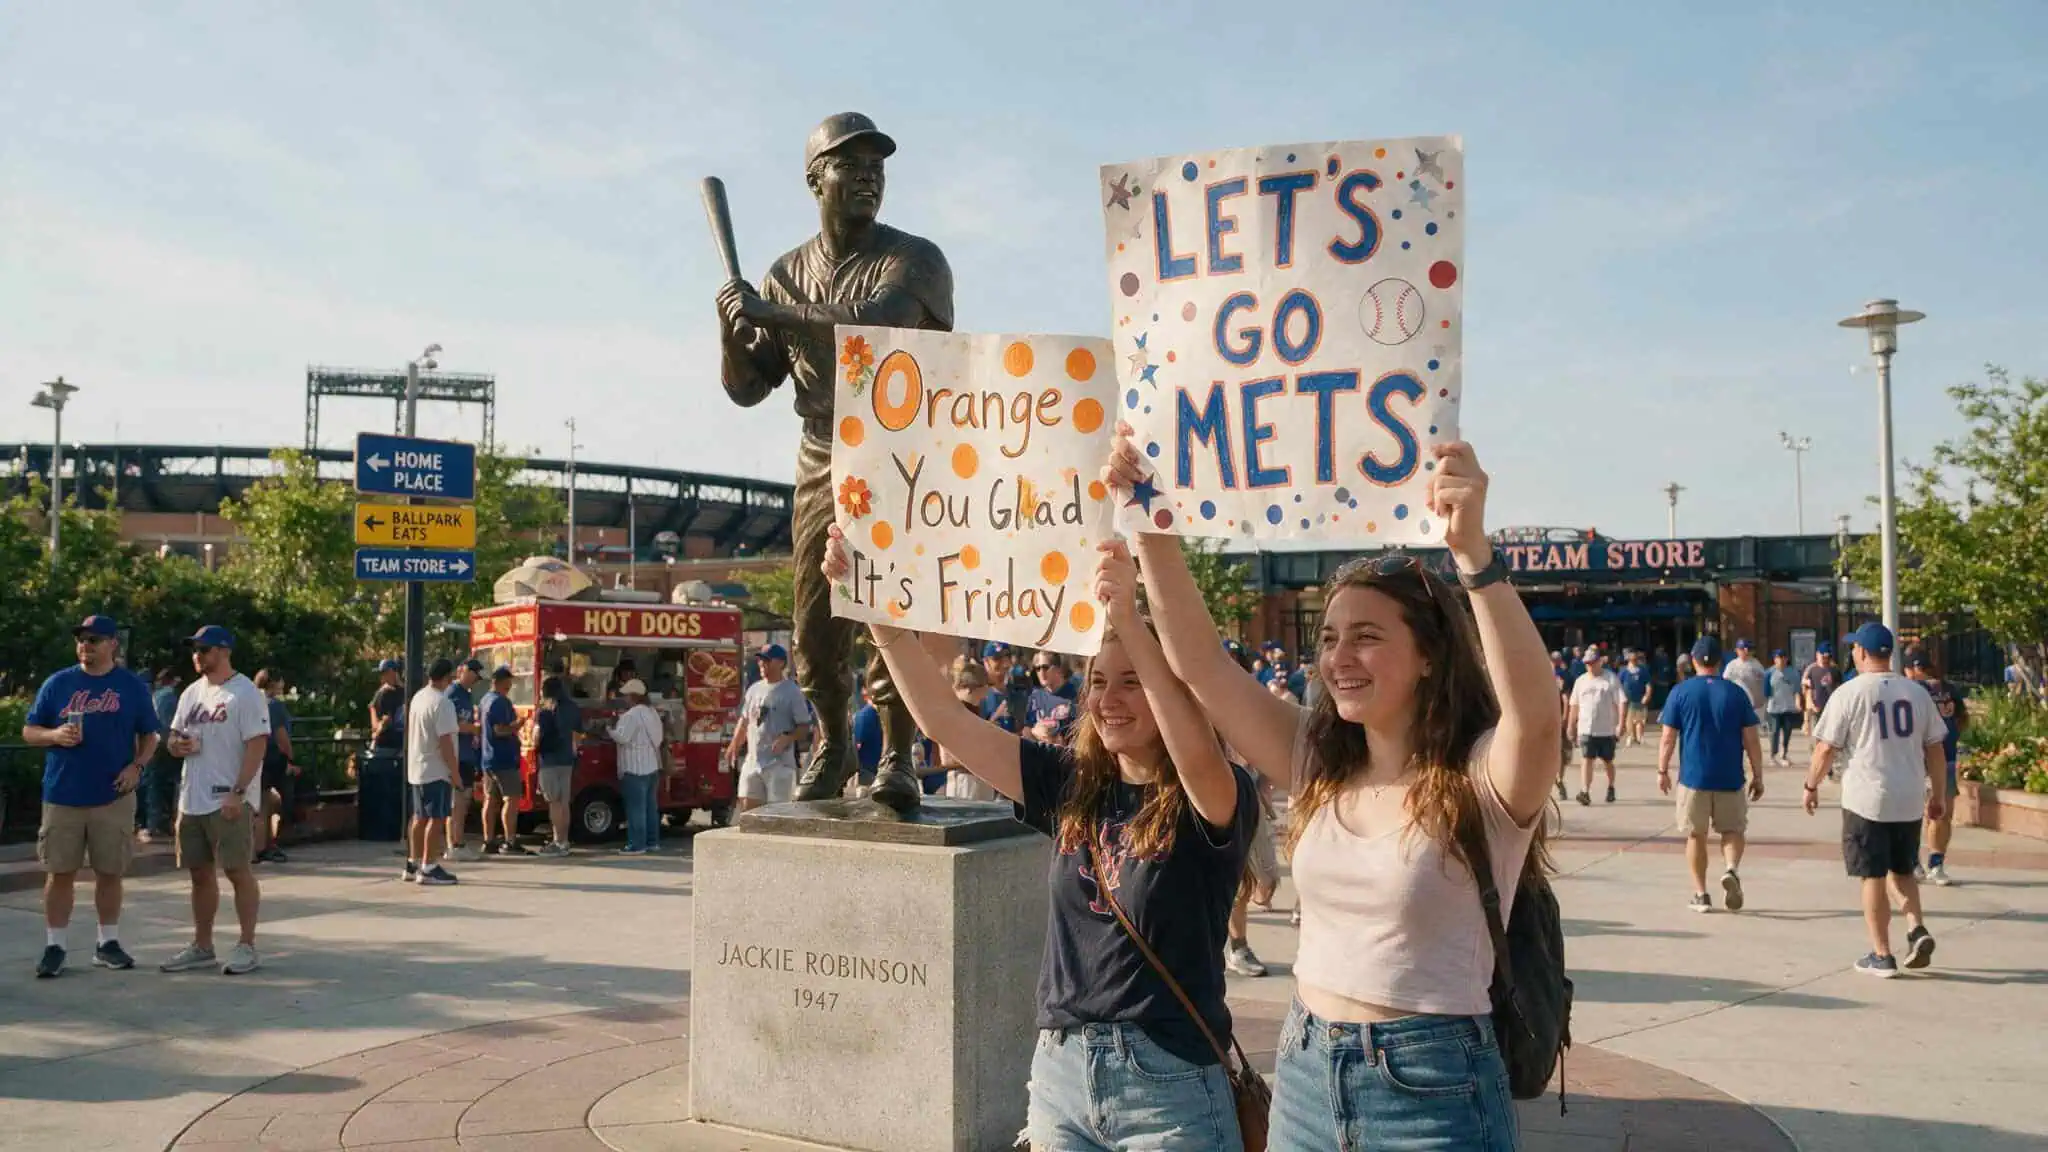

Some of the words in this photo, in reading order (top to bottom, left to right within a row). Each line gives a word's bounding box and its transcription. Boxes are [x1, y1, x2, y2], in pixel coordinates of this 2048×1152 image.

[1152, 153, 1383, 283] LET'S
[1213, 288, 1323, 368] GO
[871, 349, 1062, 458] Orange
[1175, 368, 1427, 490] METS
[394, 451, 443, 471] HOME
[394, 472, 444, 492] PLACE
[891, 451, 970, 534] You
[988, 474, 1084, 531] Glad
[392, 511, 463, 528] BALLPARK
[392, 527, 427, 540] EATS
[361, 558, 400, 573] TEAM
[404, 558, 447, 574] STORE
[1505, 544, 1591, 571] TEAM
[1607, 540, 1705, 570] STORE
[853, 550, 913, 610] It's
[937, 552, 1065, 647] Friday
[584, 610, 632, 635] HOT
[641, 612, 702, 636] DOGS
[58, 687, 121, 719] Mets
[1872, 699, 1914, 740] 10
[717, 942, 795, 972] JACKIE
[806, 951, 928, 987] ROBINSON
[793, 987, 839, 1012] 1947
